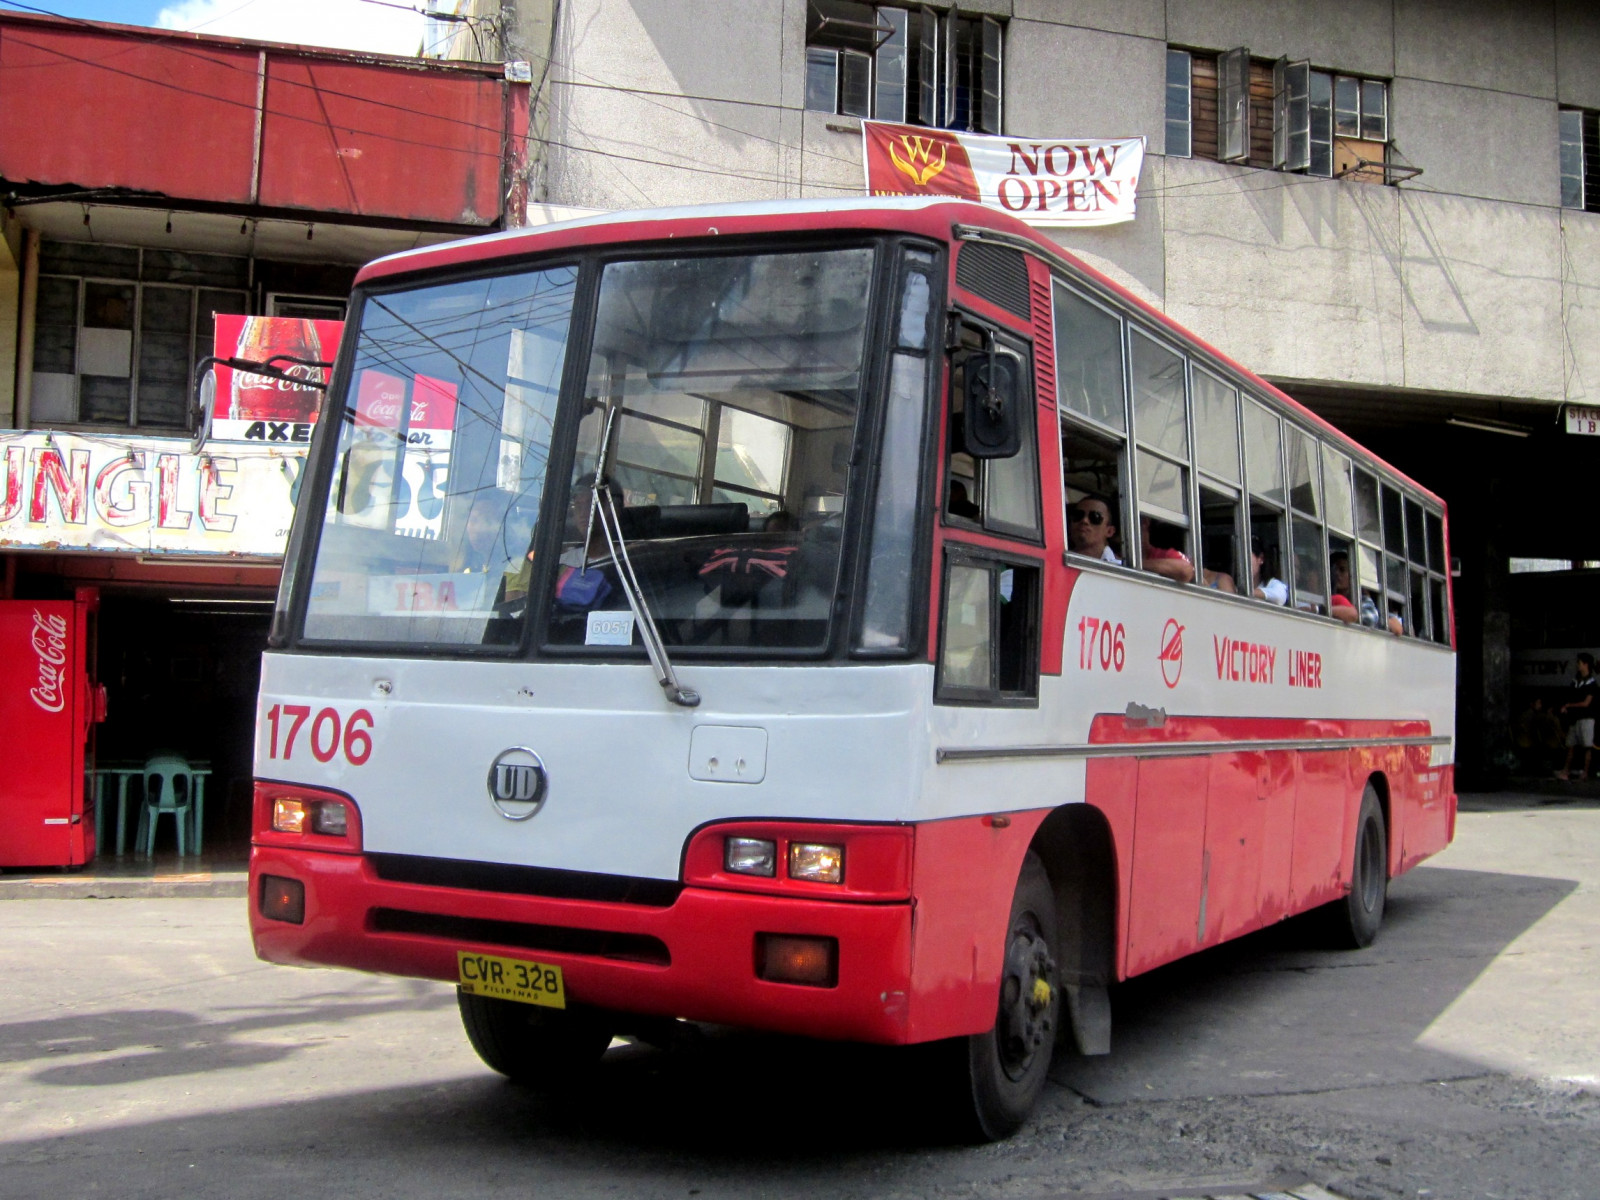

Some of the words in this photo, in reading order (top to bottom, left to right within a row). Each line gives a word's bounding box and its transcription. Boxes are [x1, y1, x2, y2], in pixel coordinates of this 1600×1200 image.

[1007, 143, 1121, 177] NOW
[997, 177, 1121, 211] OPEN
[245, 421, 311, 442] AXE
[394, 581, 459, 611] IBA
[592, 620, 629, 635] 6051
[1078, 615, 1126, 673] 1706
[1213, 633, 1277, 685] VICTORY
[1288, 649, 1322, 689] LINER
[267, 703, 375, 767] 1706
[496, 764, 539, 801] UD
[461, 956, 504, 985] CVR
[514, 964, 558, 994] 328
